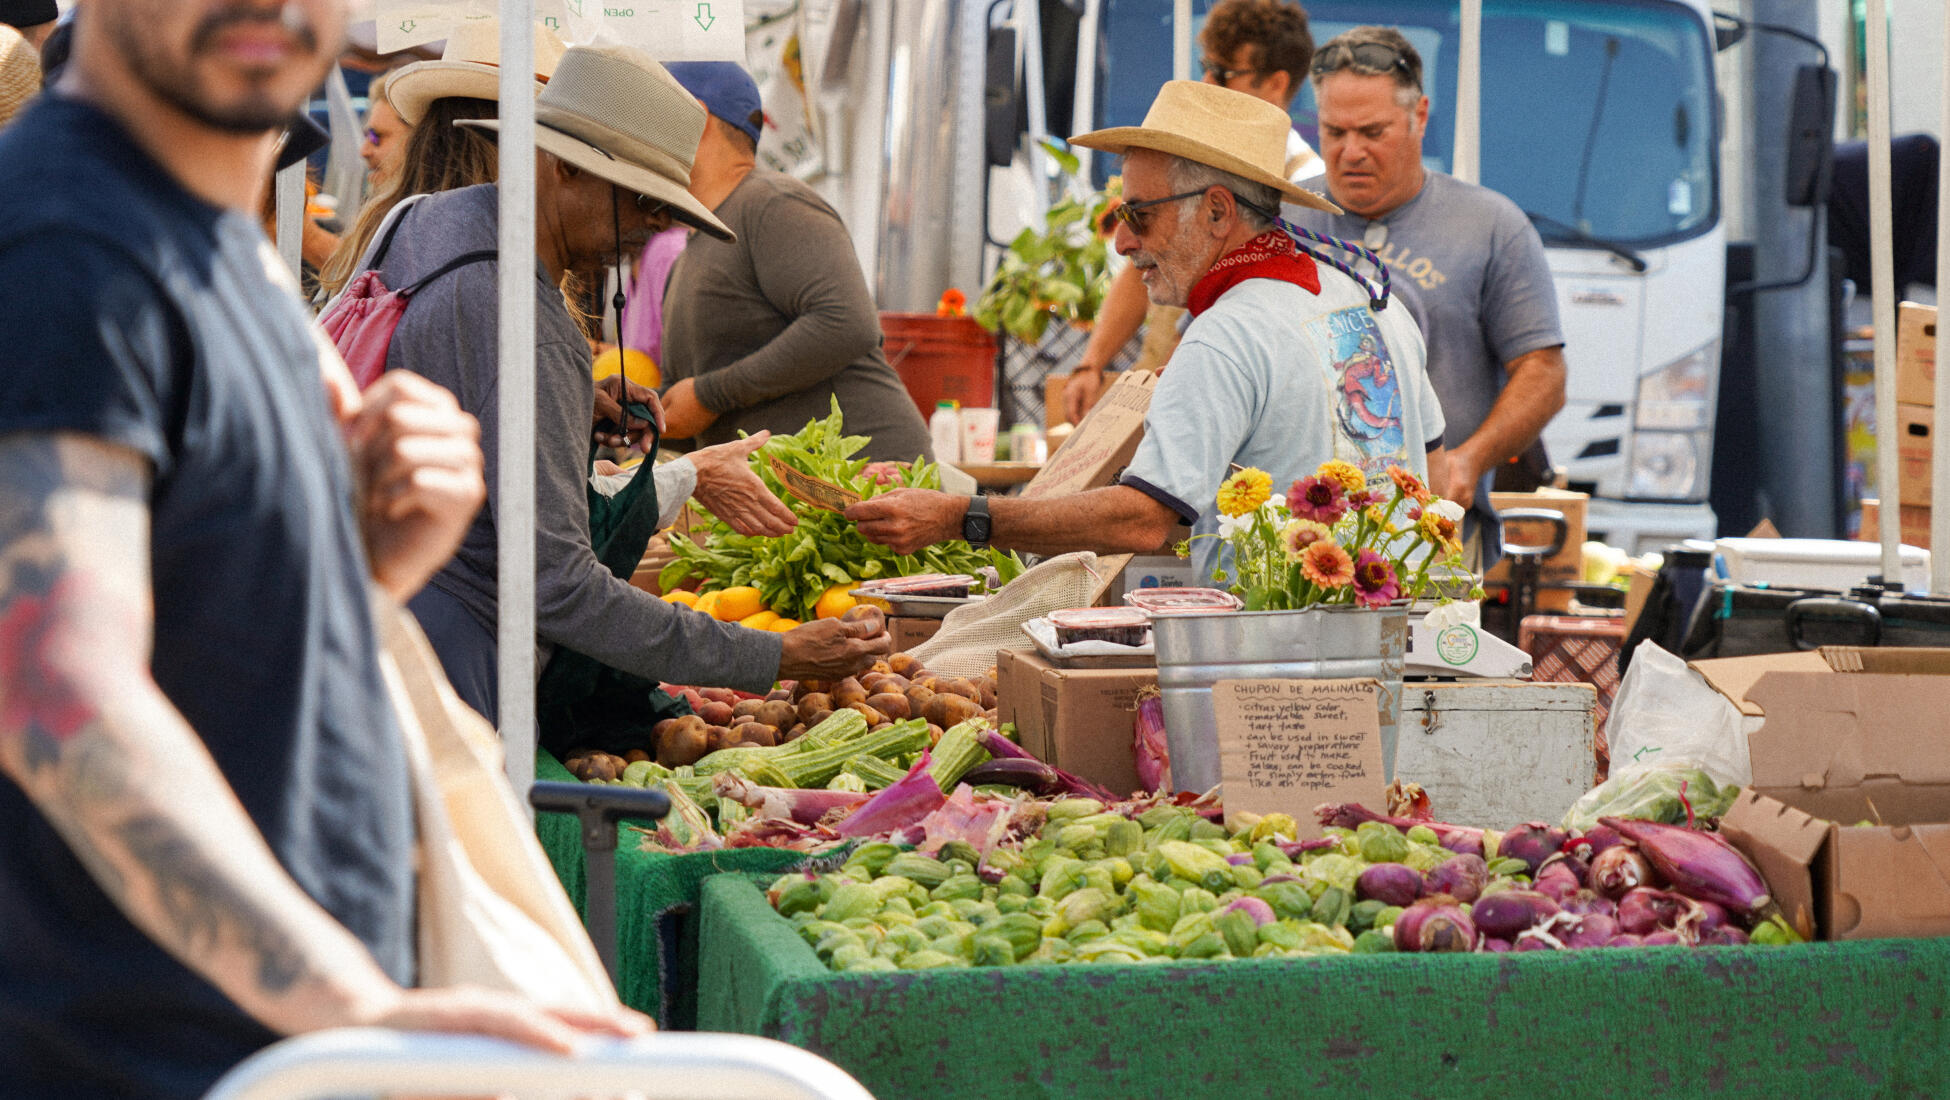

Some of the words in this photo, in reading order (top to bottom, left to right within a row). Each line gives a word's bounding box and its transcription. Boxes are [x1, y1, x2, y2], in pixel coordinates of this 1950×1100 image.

[603, 8, 634, 17] OPEN
[1234, 684, 1280, 694] CHUPON
[1289, 685, 1303, 694] DE
[1312, 684, 1373, 694] MALINALCO
[1244, 703, 1275, 711] citrus
[1279, 702, 1311, 716] yellow
[1315, 703, 1340, 711] color
[1244, 711, 1304, 720] remarkable
[1248, 722, 1273, 731] tart
[1278, 721, 1305, 731] taste
[1270, 731, 1283, 740] be
[1287, 731, 1312, 742] used
[1318, 731, 1329, 740] in
[1334, 731, 1368, 741] sweet
[1258, 742, 1289, 752] savory
[1250, 750, 1276, 760] Fruit
[1281, 750, 1301, 761] used
[1304, 750, 1316, 760] to
[1321, 752, 1352, 760] make
[1310, 761, 1321, 770] be
[1327, 759, 1361, 770] cooked
[1269, 770, 1303, 782] simply
[1249, 779, 1272, 788] like
[1278, 780, 1294, 788] an
[1301, 780, 1336, 791] apple
